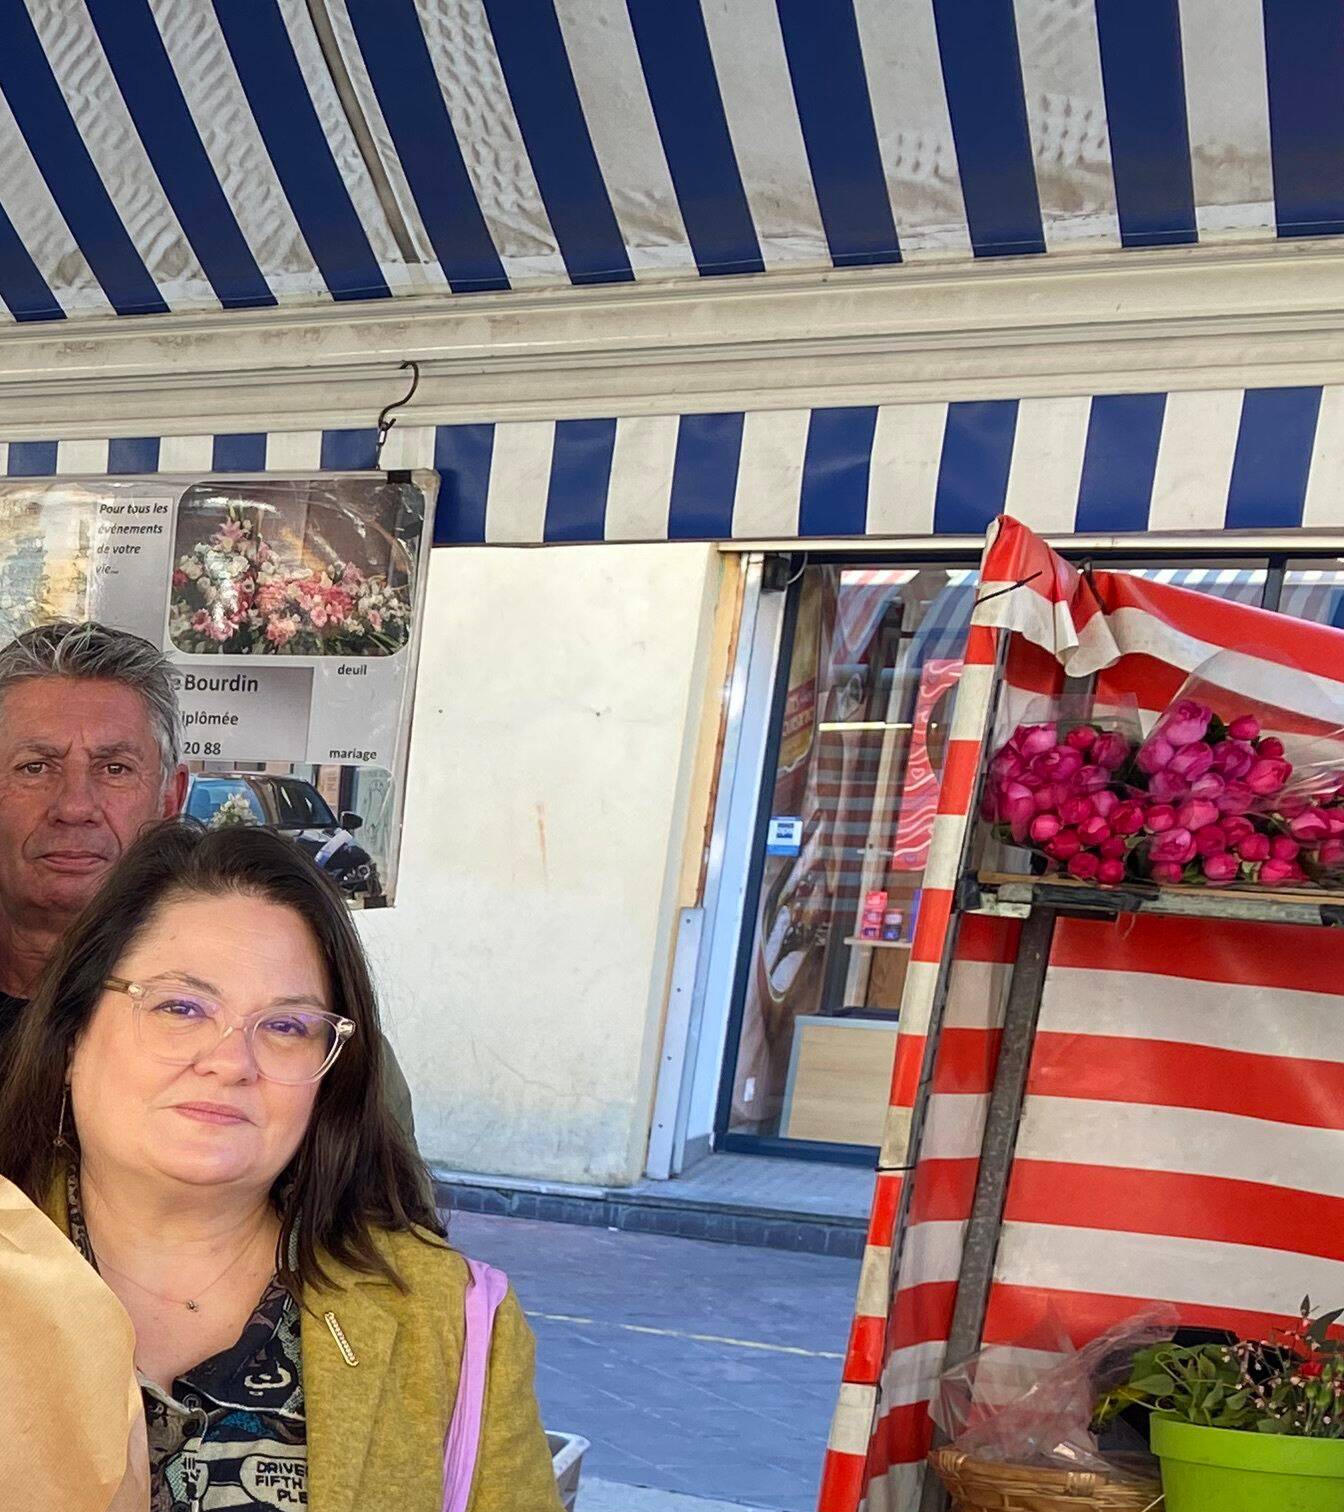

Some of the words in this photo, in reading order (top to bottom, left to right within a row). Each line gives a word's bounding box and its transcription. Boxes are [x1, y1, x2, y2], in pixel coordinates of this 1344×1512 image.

[99, 503, 125, 514] Pour
[127, 503, 150, 514] tous
[153, 502, 168, 514] les
[97, 543, 110, 554] de
[113, 544, 141, 554] votre
[337, 664, 367, 676] deuil
[185, 674, 258, 692] Bourdin
[182, 711, 239, 726] iplômée
[183, 742, 200, 755] 20
[204, 742, 221, 755] 88
[329, 749, 377, 761] mariage
[256, 1460, 307, 1477] DRIVE
[255, 1474, 303, 1490] FIFTH
[277, 1488, 307, 1504] PLE
